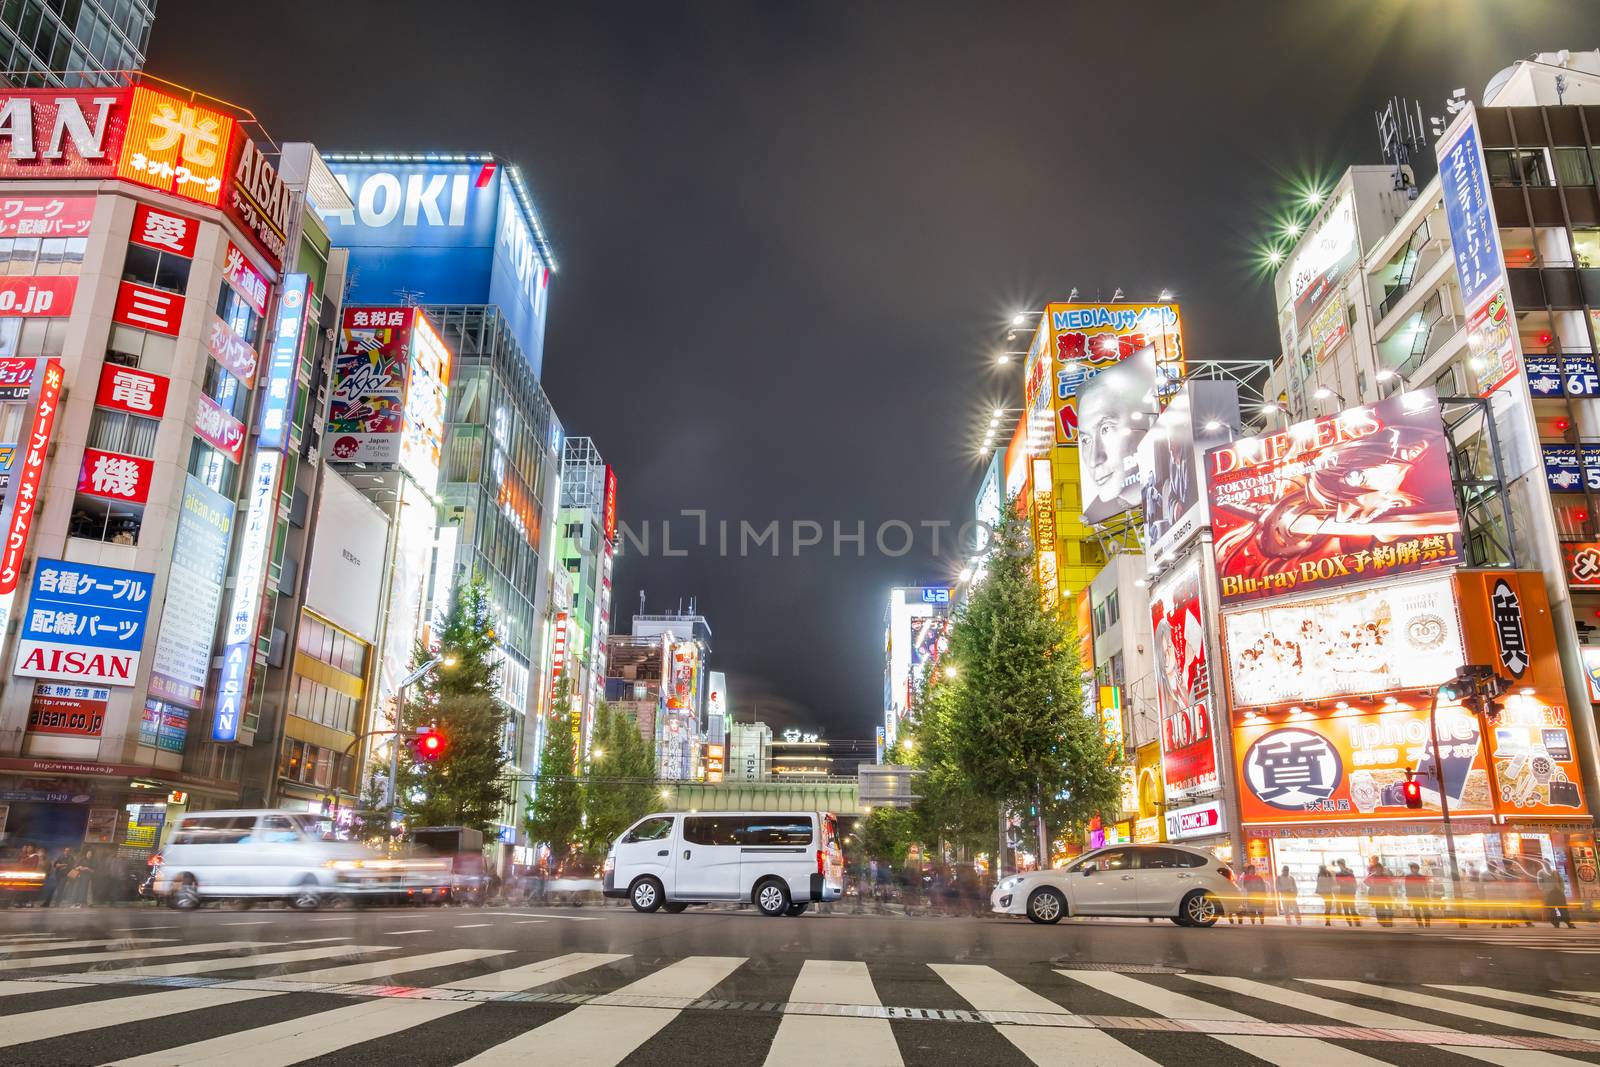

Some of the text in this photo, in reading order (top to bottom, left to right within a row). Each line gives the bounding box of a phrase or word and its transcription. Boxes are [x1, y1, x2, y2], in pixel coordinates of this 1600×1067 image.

[147, 102, 219, 168] 光
[130, 153, 221, 192] ネットワーク
[235, 137, 293, 237] AISAN
[0, 199, 65, 218] ワーク
[501, 191, 543, 319] AOKI
[223, 247, 267, 308] 光通信
[353, 311, 404, 327] 免税店
[91, 211, 187, 498] 愛 三 電 機
[209, 322, 257, 379] ネットワーク
[1567, 374, 1600, 395] 6F
[195, 402, 245, 453] 配線パーツ
[2, 368, 59, 584] 光・ケーブル・ネットワーク
[1215, 478, 1257, 496] TOKYO
[1216, 484, 1274, 507] 23:00 FRI
[184, 493, 231, 535] aisan.co.jp
[1221, 533, 1457, 597] Blu-ray BOX 予約解禁!
[39, 568, 147, 602] 各種ケーブル
[30, 609, 140, 641] 配線パーツ
[21, 647, 132, 679] AISAN
[74, 688, 90, 698] 在庫
[218, 646, 243, 730] AISAN
[31, 707, 103, 733] aisan.co.jp
[33, 762, 114, 774] http://www.aisan.co.jp
[1254, 736, 1339, 803] 質
[1181, 813, 1200, 831] COMIC
[1200, 810, 1209, 827] ZIN
